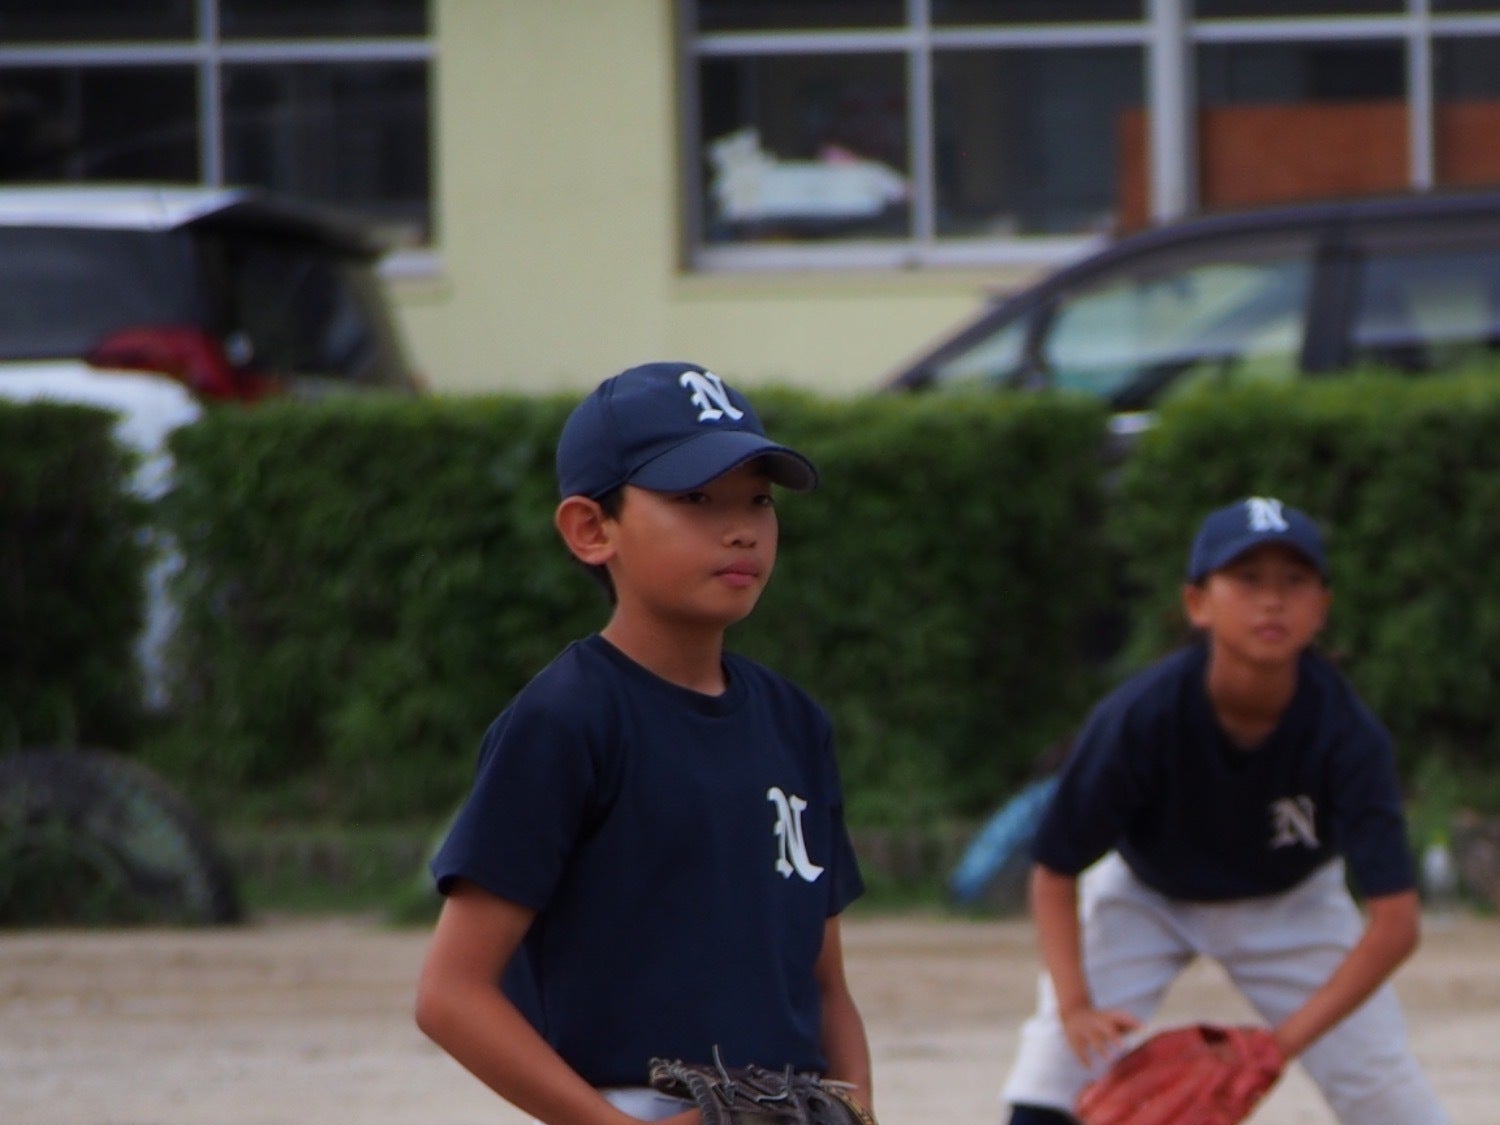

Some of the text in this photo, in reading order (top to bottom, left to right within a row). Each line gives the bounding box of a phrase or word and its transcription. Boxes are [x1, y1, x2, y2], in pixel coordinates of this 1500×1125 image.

[680, 371, 744, 421] N
[1247, 497, 1289, 532] N
[767, 786, 824, 882] N
[1269, 796, 1321, 848] N
